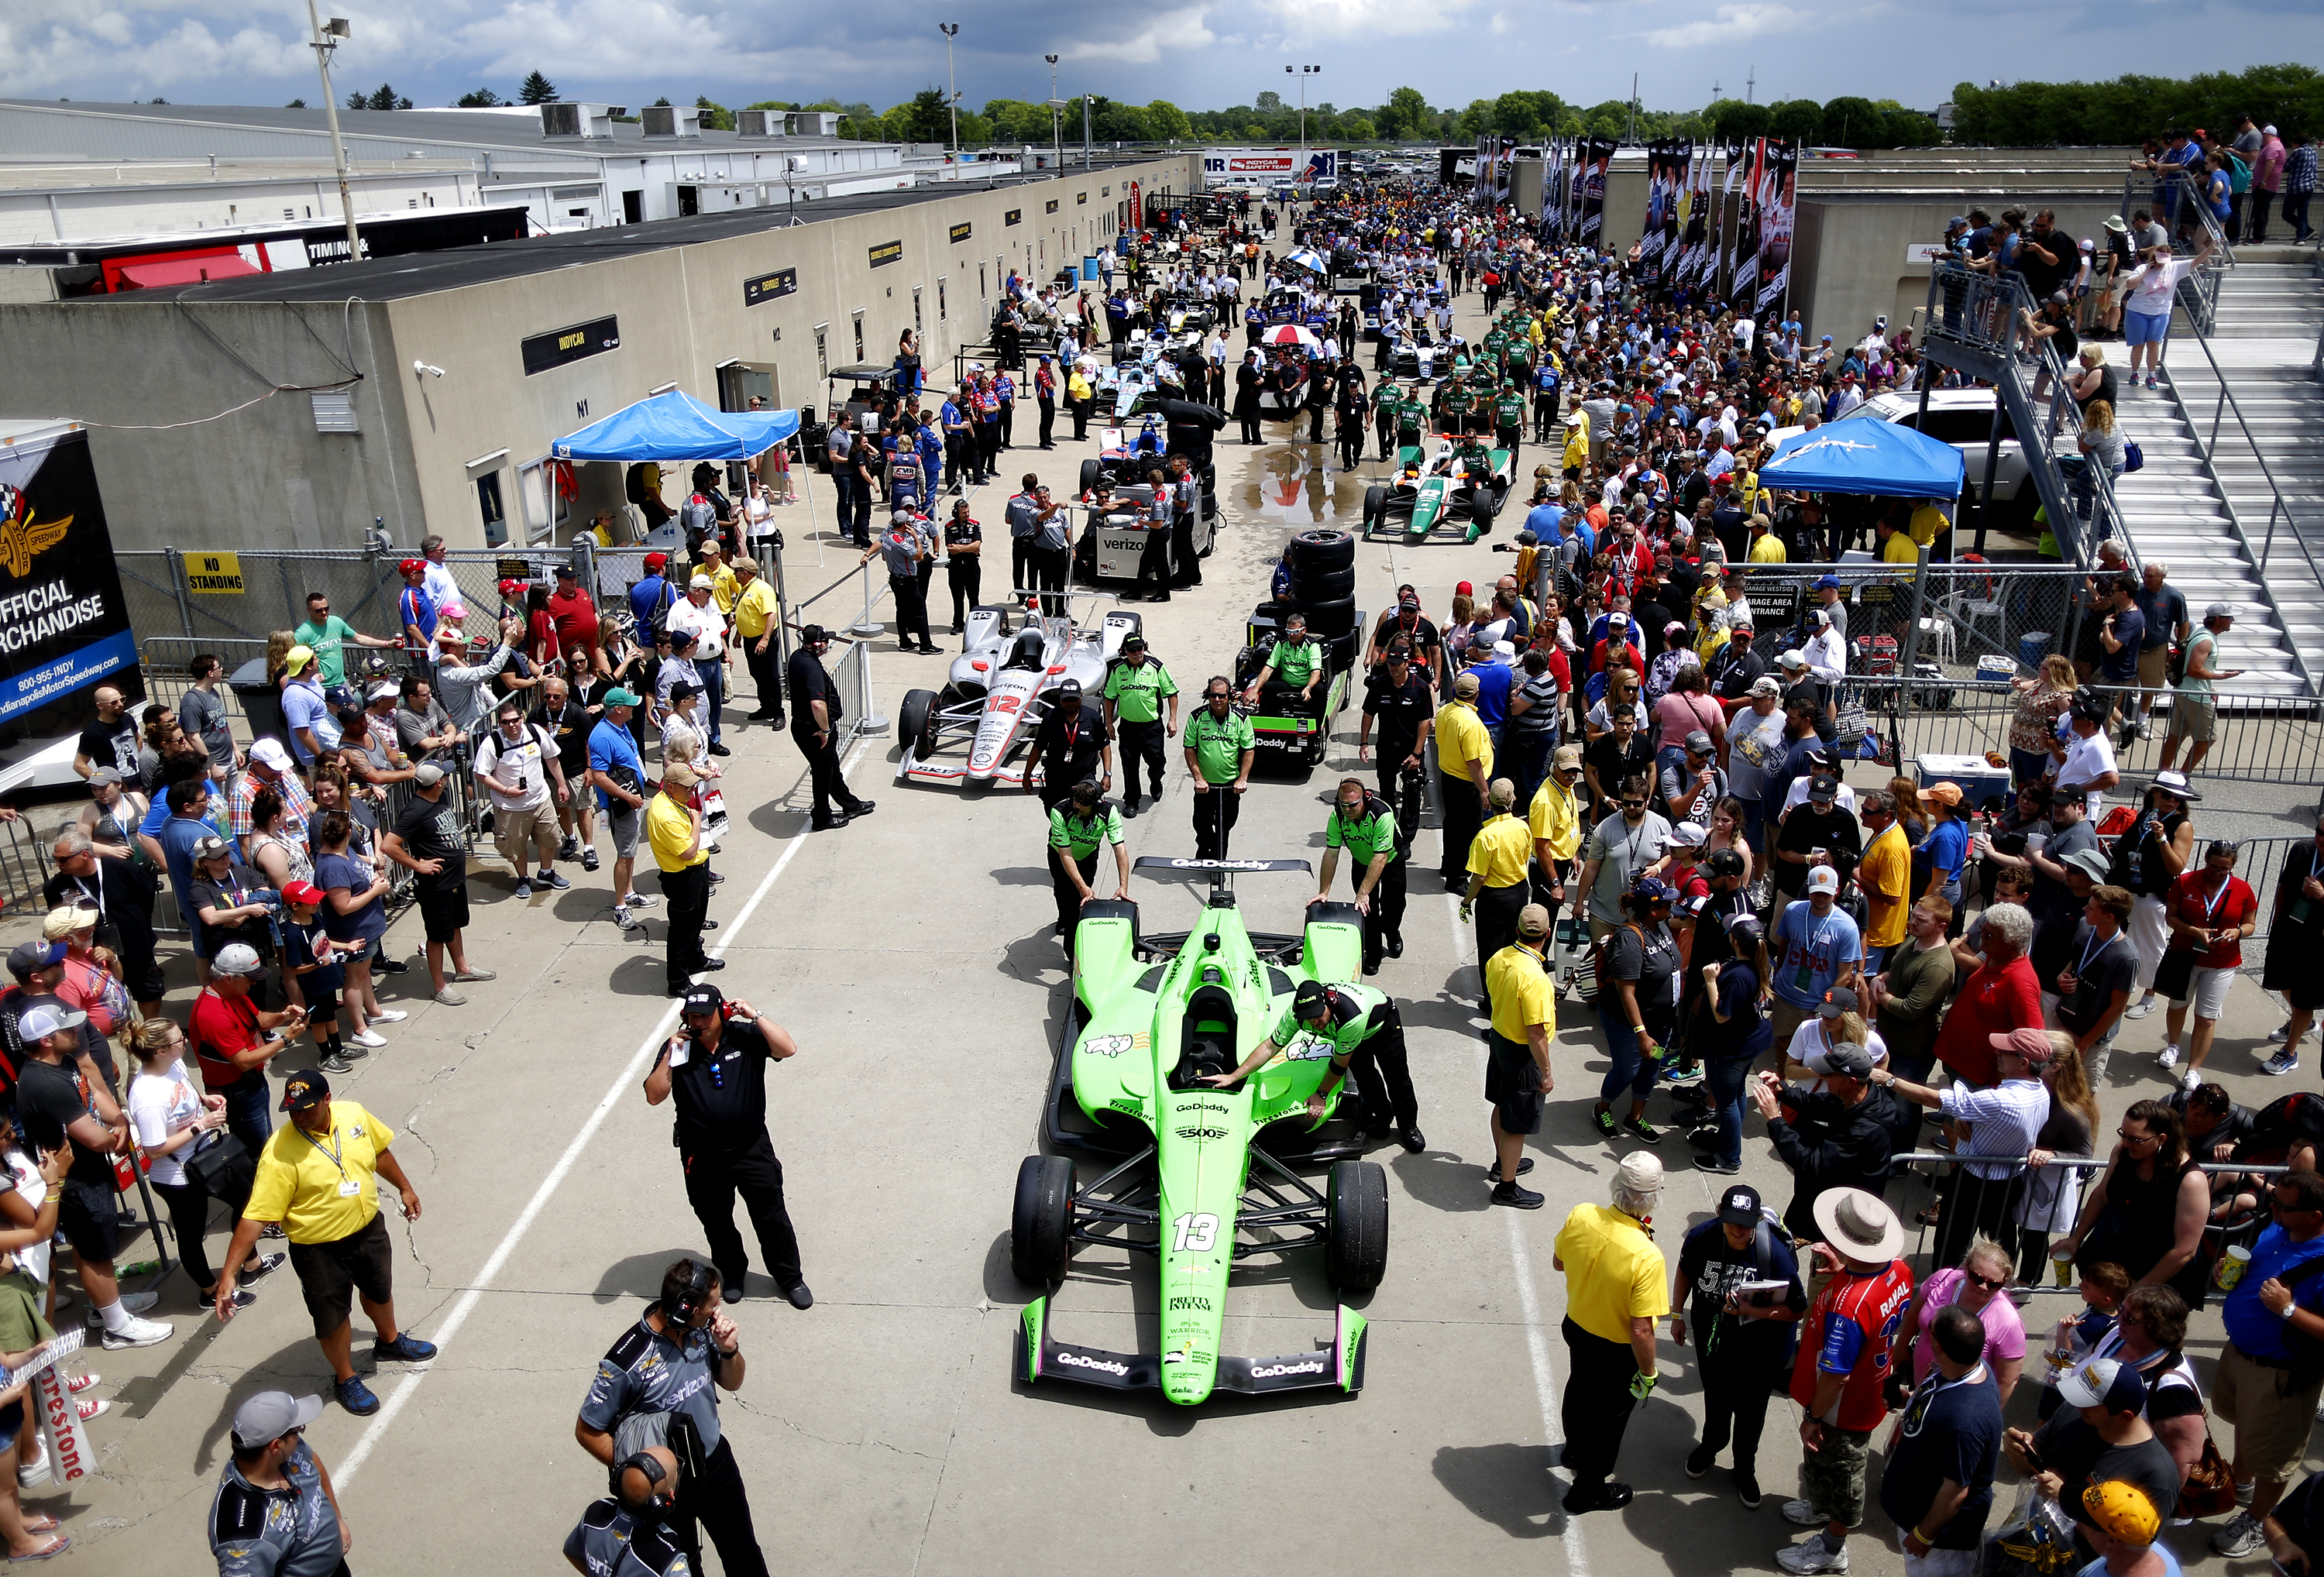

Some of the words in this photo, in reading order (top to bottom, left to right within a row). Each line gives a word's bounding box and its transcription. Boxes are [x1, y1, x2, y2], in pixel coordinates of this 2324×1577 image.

[359, 238, 369, 252] &
[1763, 270, 1776, 281] 14
[559, 332, 585, 350] INDYCAR
[576, 398, 589, 419] N1
[30, 528, 62, 546] SPEEDWAY
[1104, 538, 1146, 551] verizo
[12, 526, 29, 571] MOTOR
[204, 558, 219, 572] NO
[189, 575, 242, 589] STANDING
[0, 579, 73, 624] FFICIAL
[18, 660, 74, 692] 800-955-INDY
[0, 655, 119, 716] ndianapolisMotorSpeedway.com
[989, 683, 1026, 692] verizon
[987, 696, 1020, 714] 12
[1201, 735, 1233, 744] GoDaddy
[1253, 738, 1286, 749] oDaddy
[1069, 836, 1097, 845] oDaddy
[1171, 858, 1270, 871] GoDaddy
[1646, 946, 1657, 955] be
[1248, 957, 1261, 987] GoDaddy
[1109, 1099, 1154, 1122] Firestone
[1176, 1103, 1229, 1115] GoDaddy
[1253, 1105, 1300, 1126] Firestone
[1187, 1128, 1216, 1138] 500
[1172, 1212, 1219, 1252] 13
[1169, 1303, 1213, 1312] INTENSE
[1346, 1328, 1356, 1368] GoDaddy
[1057, 1352, 1129, 1376] GoDaddy
[1251, 1361, 1323, 1378] GoDaddy
[655, 1371, 711, 1409] verizon
[41, 1366, 84, 1481] irestone
